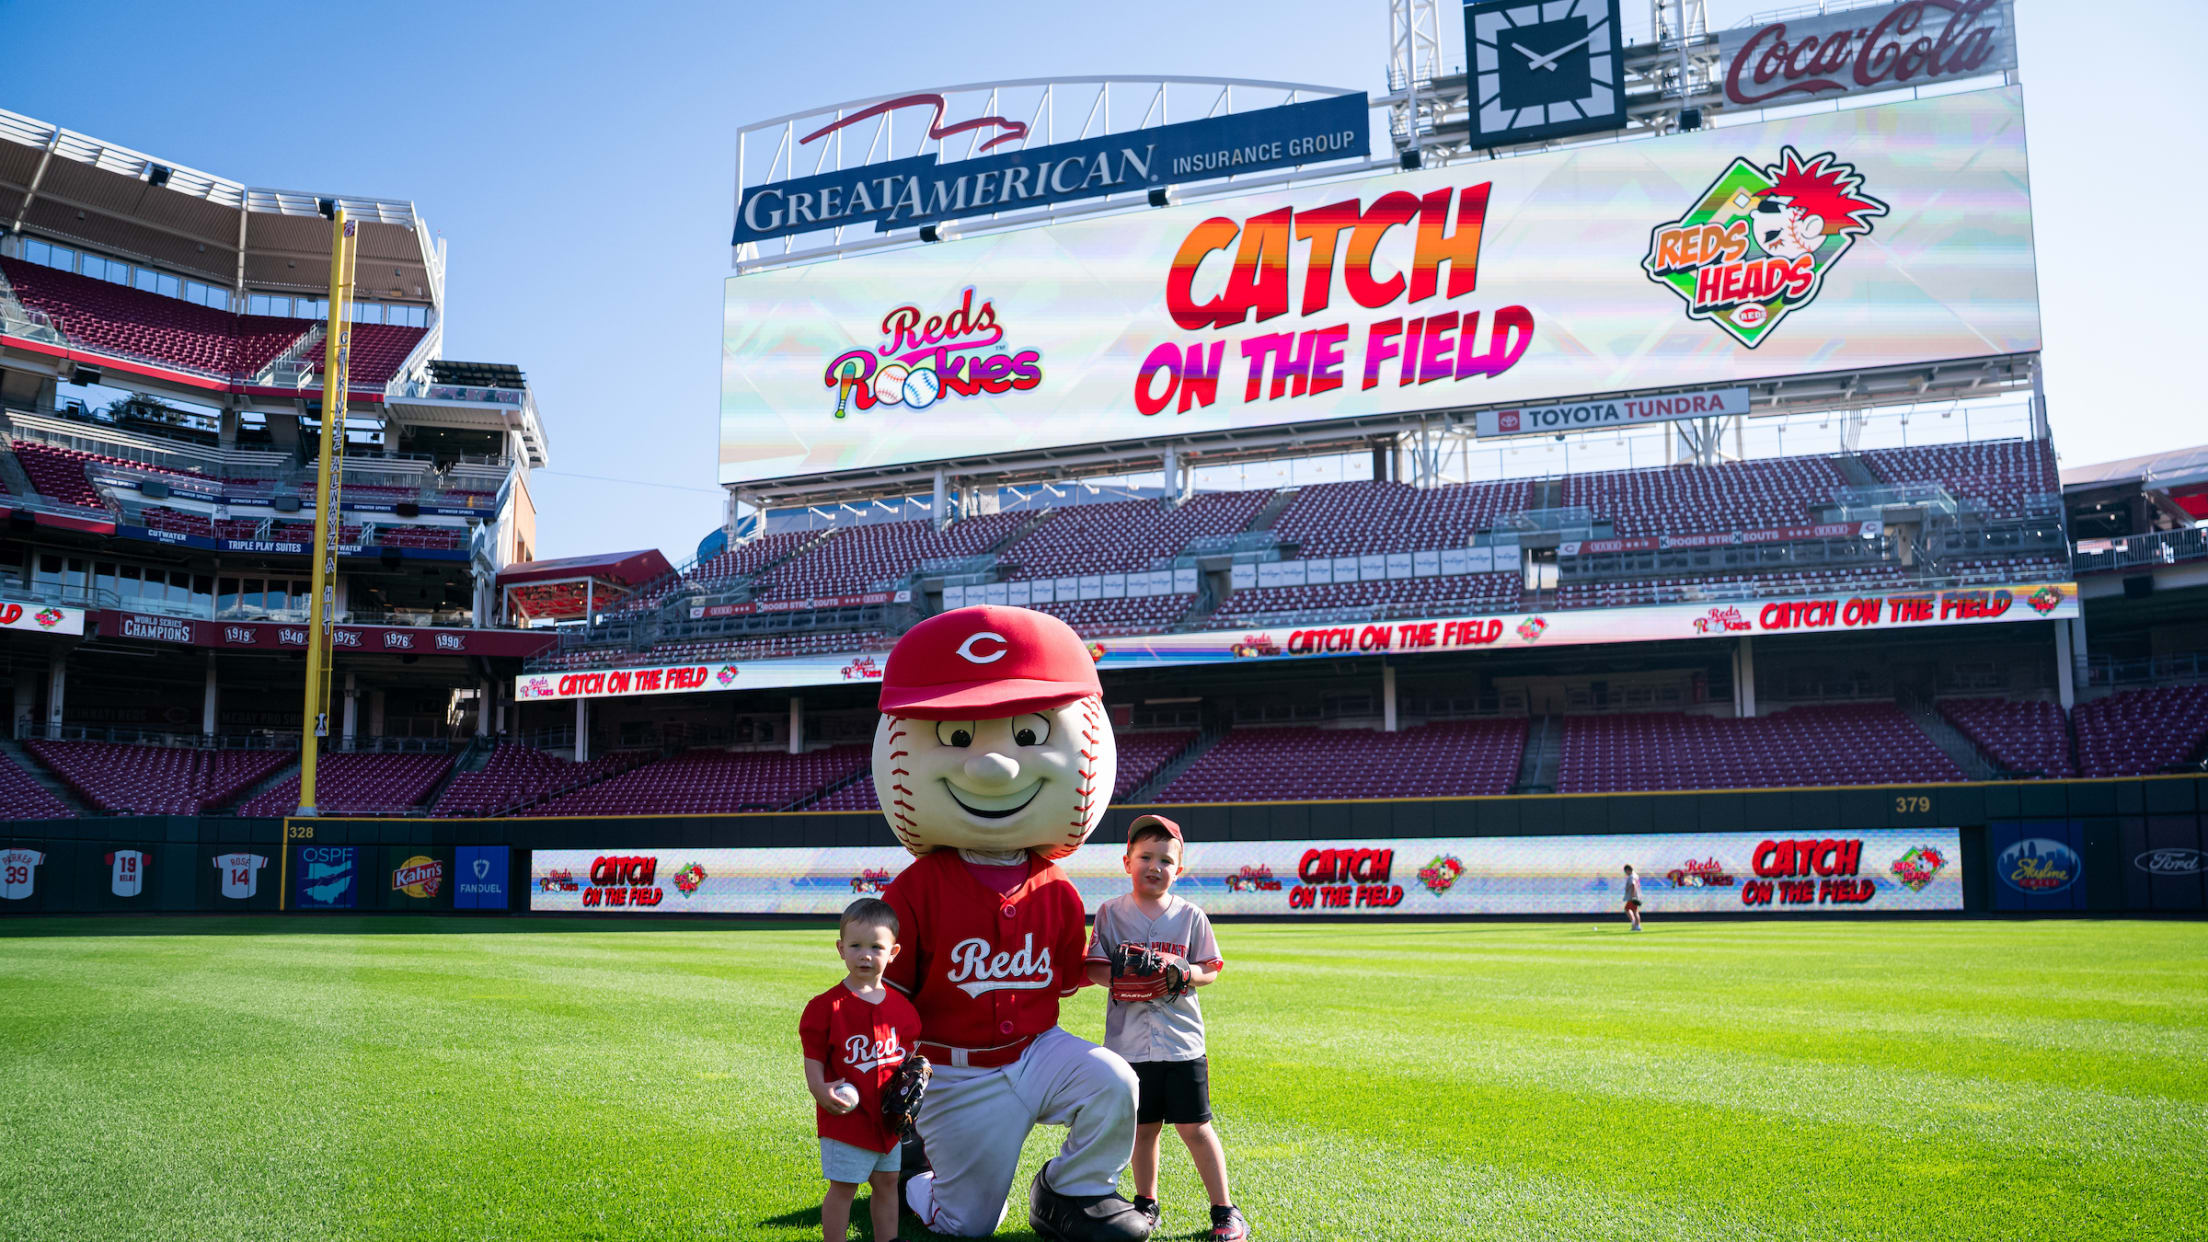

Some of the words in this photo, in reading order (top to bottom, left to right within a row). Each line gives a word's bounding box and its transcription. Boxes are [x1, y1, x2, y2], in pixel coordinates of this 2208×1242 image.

[1725, 0, 2000, 105] Coca-Cola
[1172, 142, 1284, 177] INSURANCE
[1288, 129, 1356, 155] GROUP
[1166, 181, 1493, 332] CATCH
[1656, 222, 1749, 270] REDS
[1696, 255, 1815, 305] HEADS
[878, 288, 1003, 367] Reds
[1134, 339, 1227, 417] ON
[1241, 322, 1345, 404] THE
[1361, 304, 1535, 392] FIELD
[825, 346, 1042, 412] Rookies
[1528, 404, 1620, 428] TOYOTA
[1623, 394, 1726, 420] TUNDRA
[148, 529, 187, 542] CUTWATER
[228, 540, 254, 551] TRIPLE
[255, 541, 274, 552] PLAY
[275, 542, 302, 553] SUITES
[1659, 535, 1706, 548] KROGER
[1708, 531, 1779, 546] STRIKEOUTS
[756, 601, 788, 613] KROGER
[1708, 605, 1742, 619] Reds
[1759, 599, 1838, 630] CATCH
[1842, 597, 1882, 627] ON
[1888, 592, 1935, 623] THE
[1941, 589, 2013, 620] FIELD
[124, 619, 190, 642] CHAMPIONS
[134, 616, 158, 626] WORLD
[159, 618, 183, 628] SERIES
[227, 629, 250, 643] 1919
[280, 629, 304, 644] 1940
[333, 630, 356, 645] 1975
[386, 631, 408, 647] 1976
[437, 633, 459, 648] 1990
[1287, 626, 1355, 655] CATCH
[1360, 624, 1392, 651] ON
[1399, 622, 1437, 649] THE
[1443, 618, 1504, 647] FIELD
[558, 673, 605, 696] CATCH
[607, 670, 631, 694] ON
[635, 668, 663, 692] THE
[664, 667, 708, 690] FIELD
[1895, 796, 1931, 813] 379
[289, 826, 314, 838] 328
[119, 856, 137, 873] 19
[1298, 848, 1392, 884] CATCH
[1684, 855, 1722, 873] Reds
[1752, 838, 1861, 878] CATCH
[2011, 858, 2068, 880] Skyline
[2149, 852, 2199, 871] Ford
[5, 866, 28, 884] 39
[231, 869, 249, 886] 14
[396, 863, 442, 887] Kahn's
[589, 856, 657, 886] CATCH
[460, 884, 501, 893] FANDUEL
[582, 887, 603, 907] ON
[604, 887, 629, 906] THE
[629, 886, 662, 905] FIELD
[1289, 886, 1318, 909] ON
[1320, 886, 1352, 908] THE
[1355, 885, 1404, 907] FIELD
[1741, 880, 1773, 905] ON
[1780, 880, 1815, 904] THE
[1817, 878, 1876, 904] FIELD
[948, 932, 1053, 998] Reds
